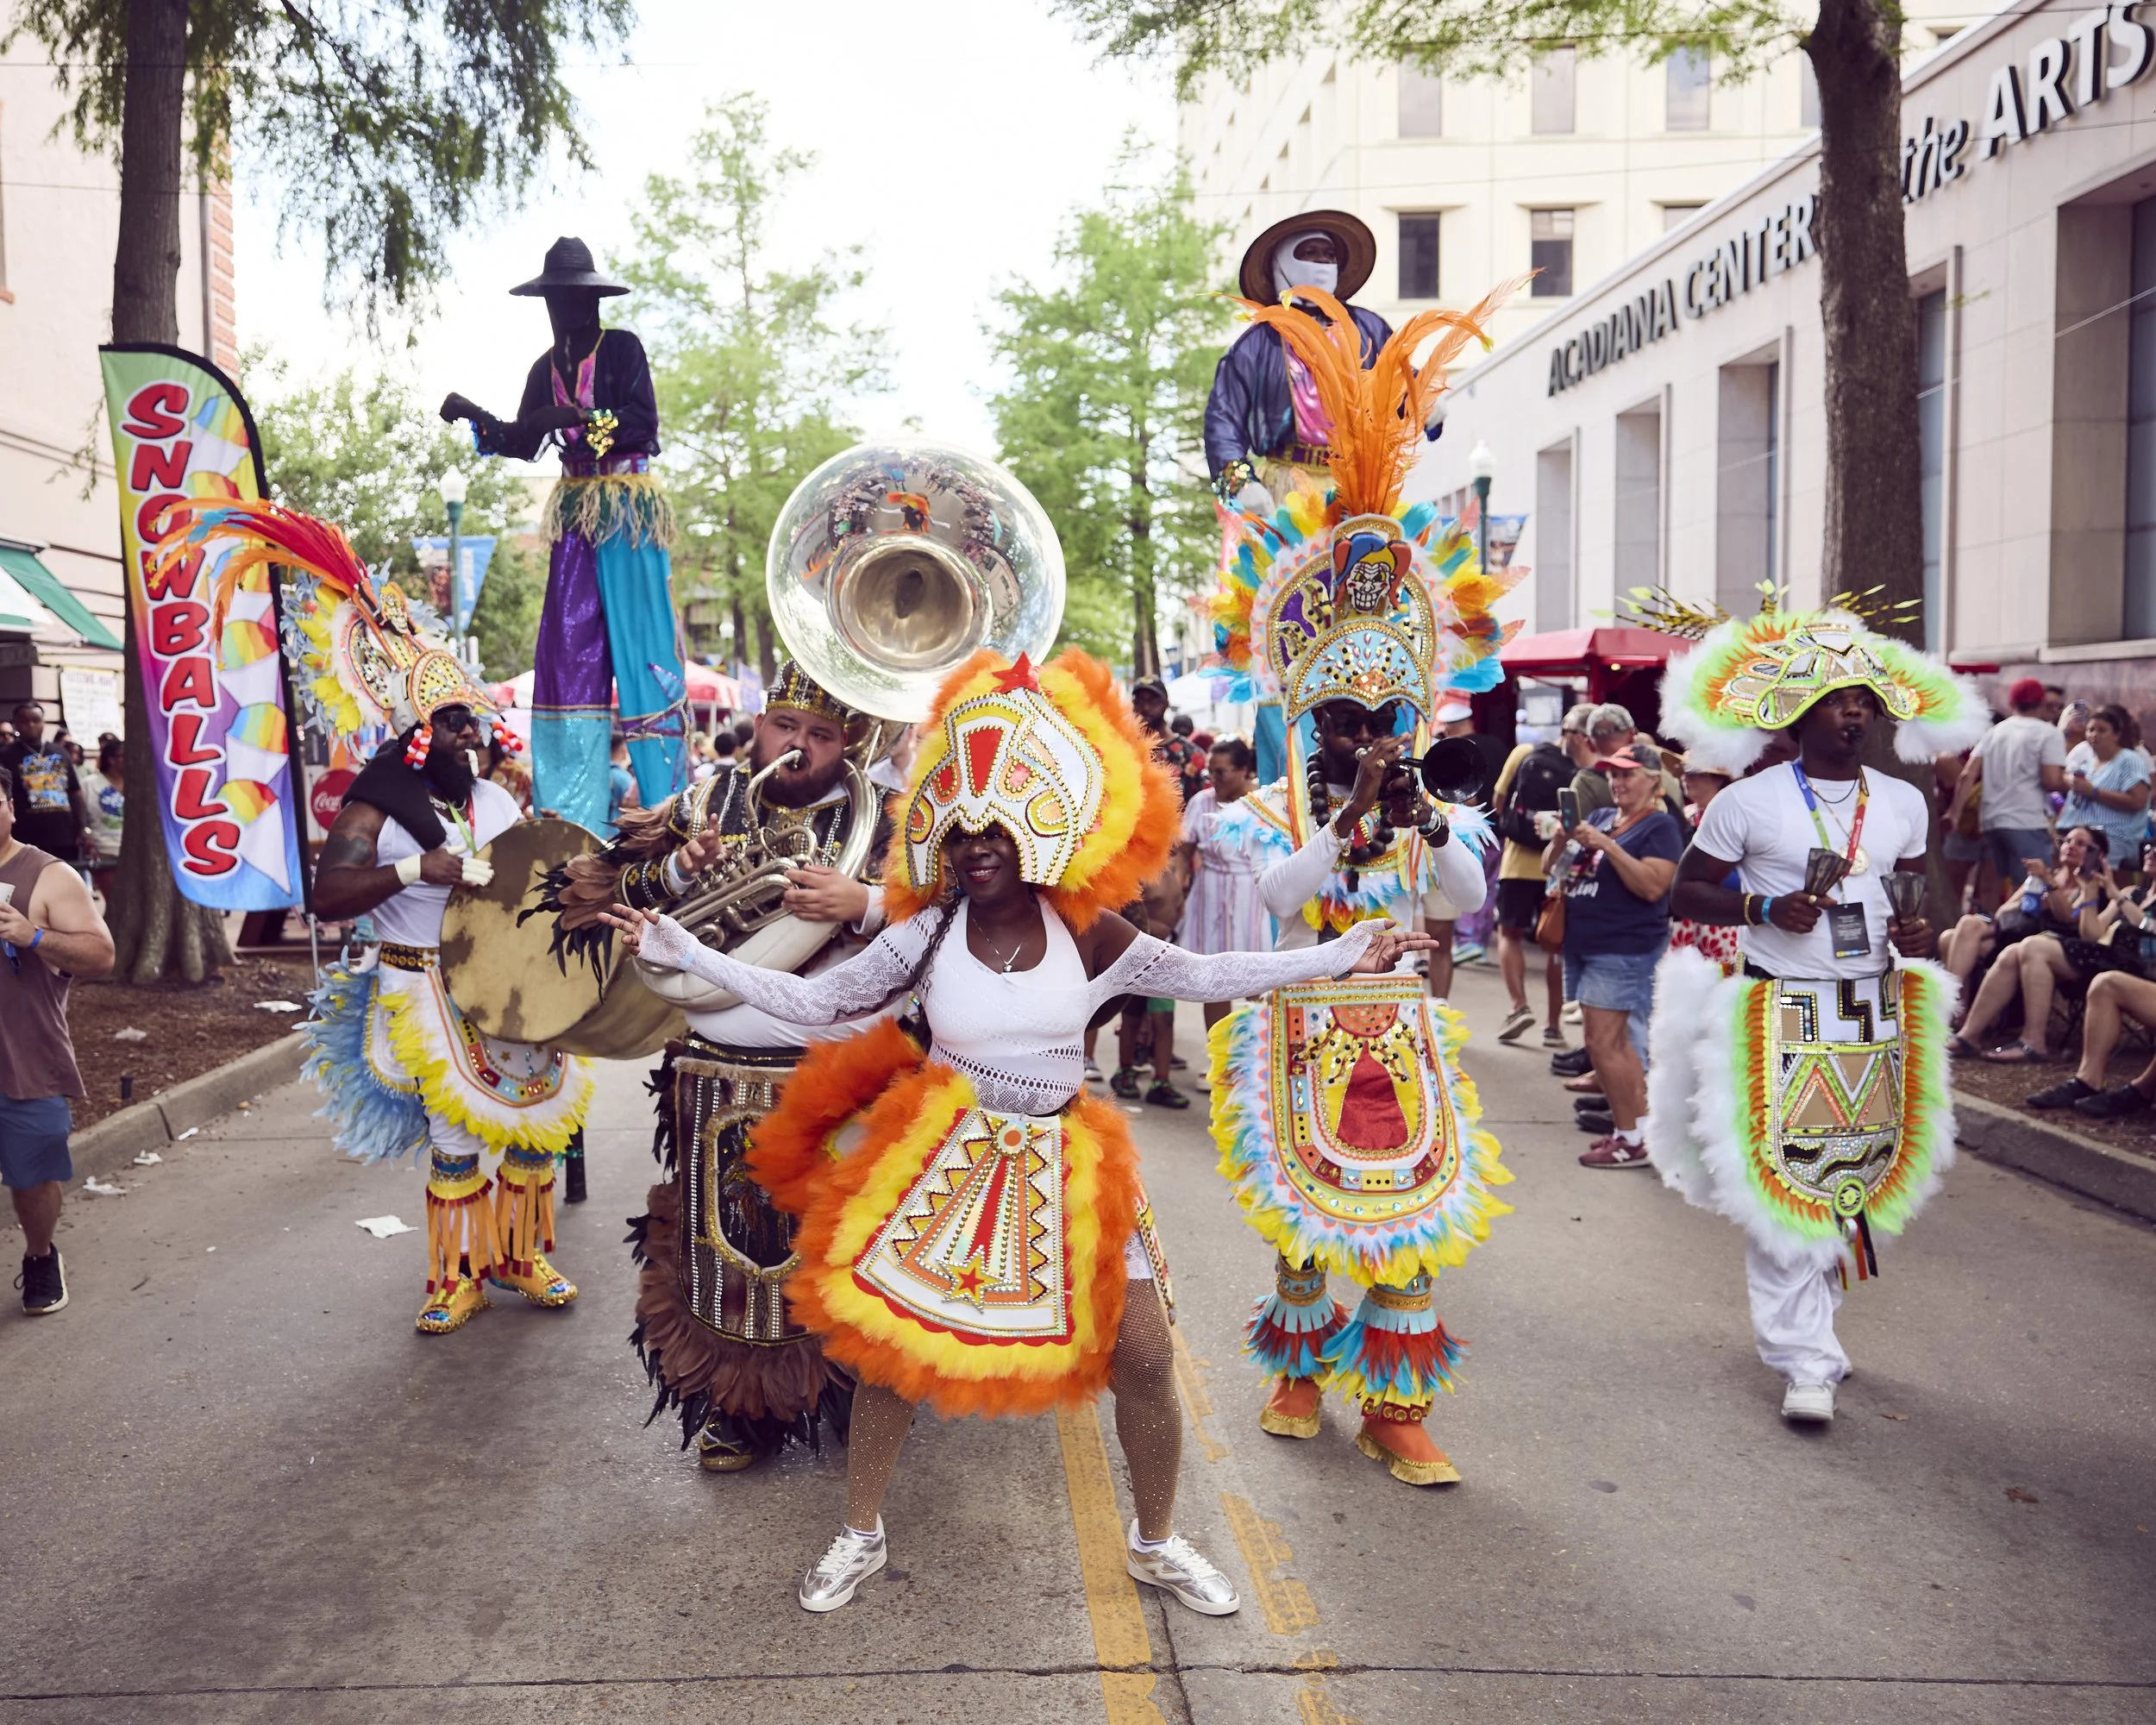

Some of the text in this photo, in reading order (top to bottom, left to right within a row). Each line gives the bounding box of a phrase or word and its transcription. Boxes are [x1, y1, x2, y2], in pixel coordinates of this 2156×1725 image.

[1547, 0, 2154, 398] ACADIANA CENTER the ARTS
[122, 382, 241, 876] SNOWBALLS
